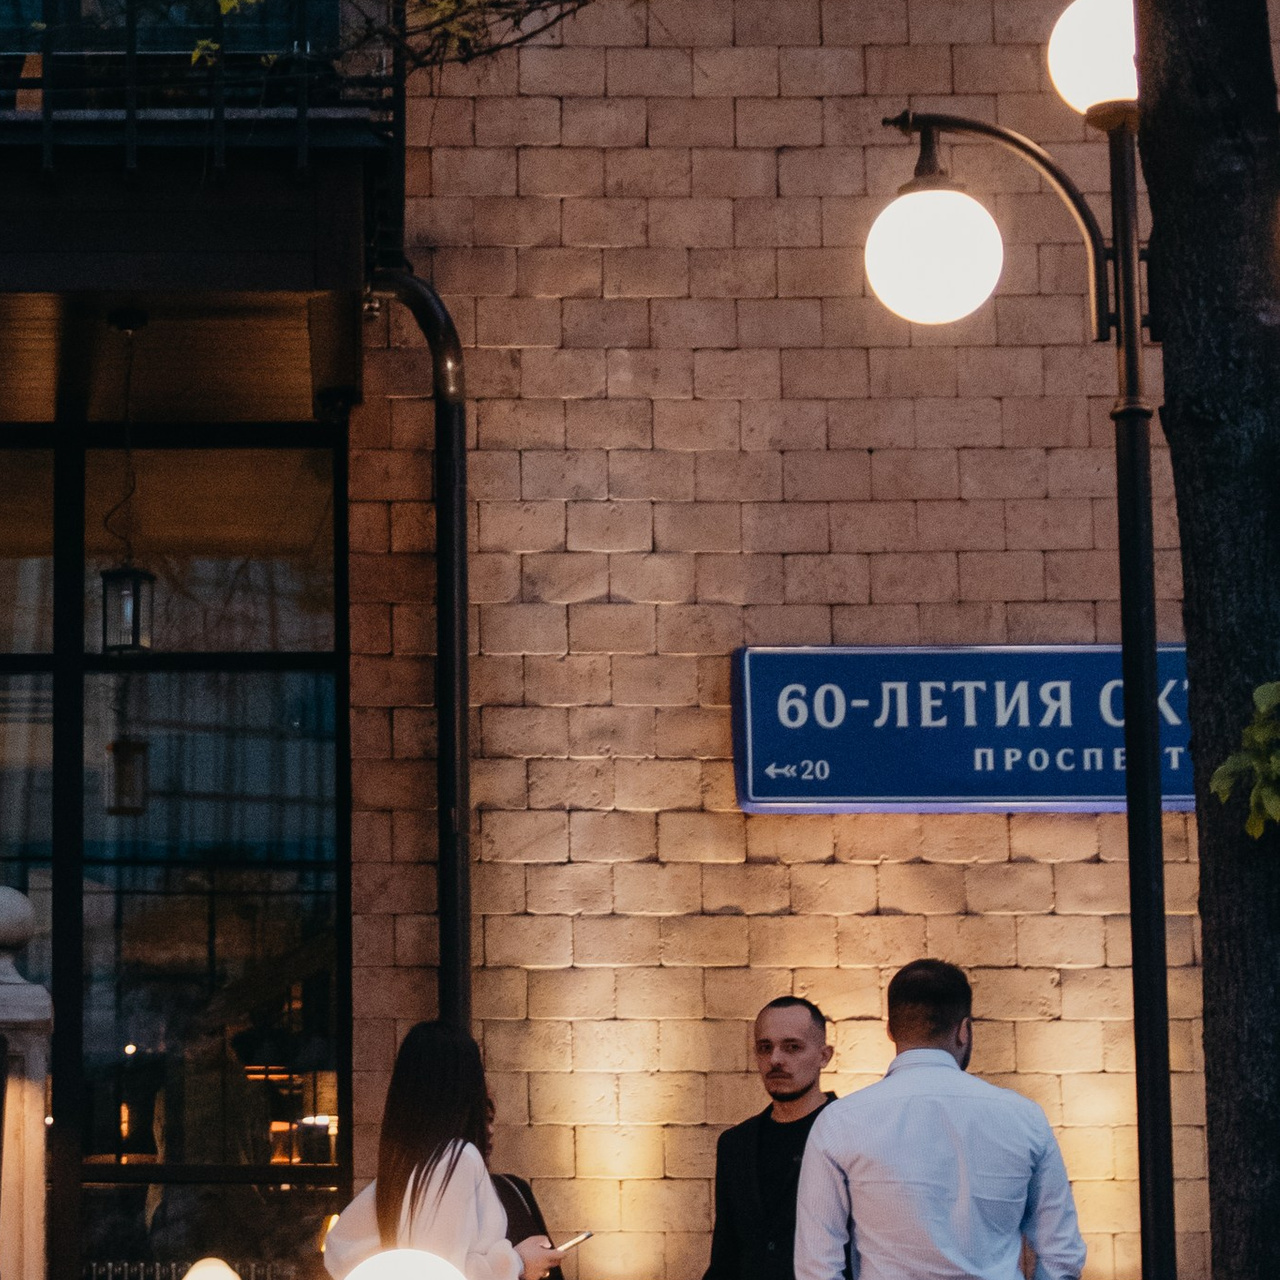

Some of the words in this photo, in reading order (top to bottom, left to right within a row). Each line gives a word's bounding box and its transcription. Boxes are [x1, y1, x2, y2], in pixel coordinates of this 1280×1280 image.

[776, 680, 1073, 730] 60-ЛЕТИЯ
[799, 758, 831, 781] 20
[973, 746, 1186, 772] ПРОСПЕТ
